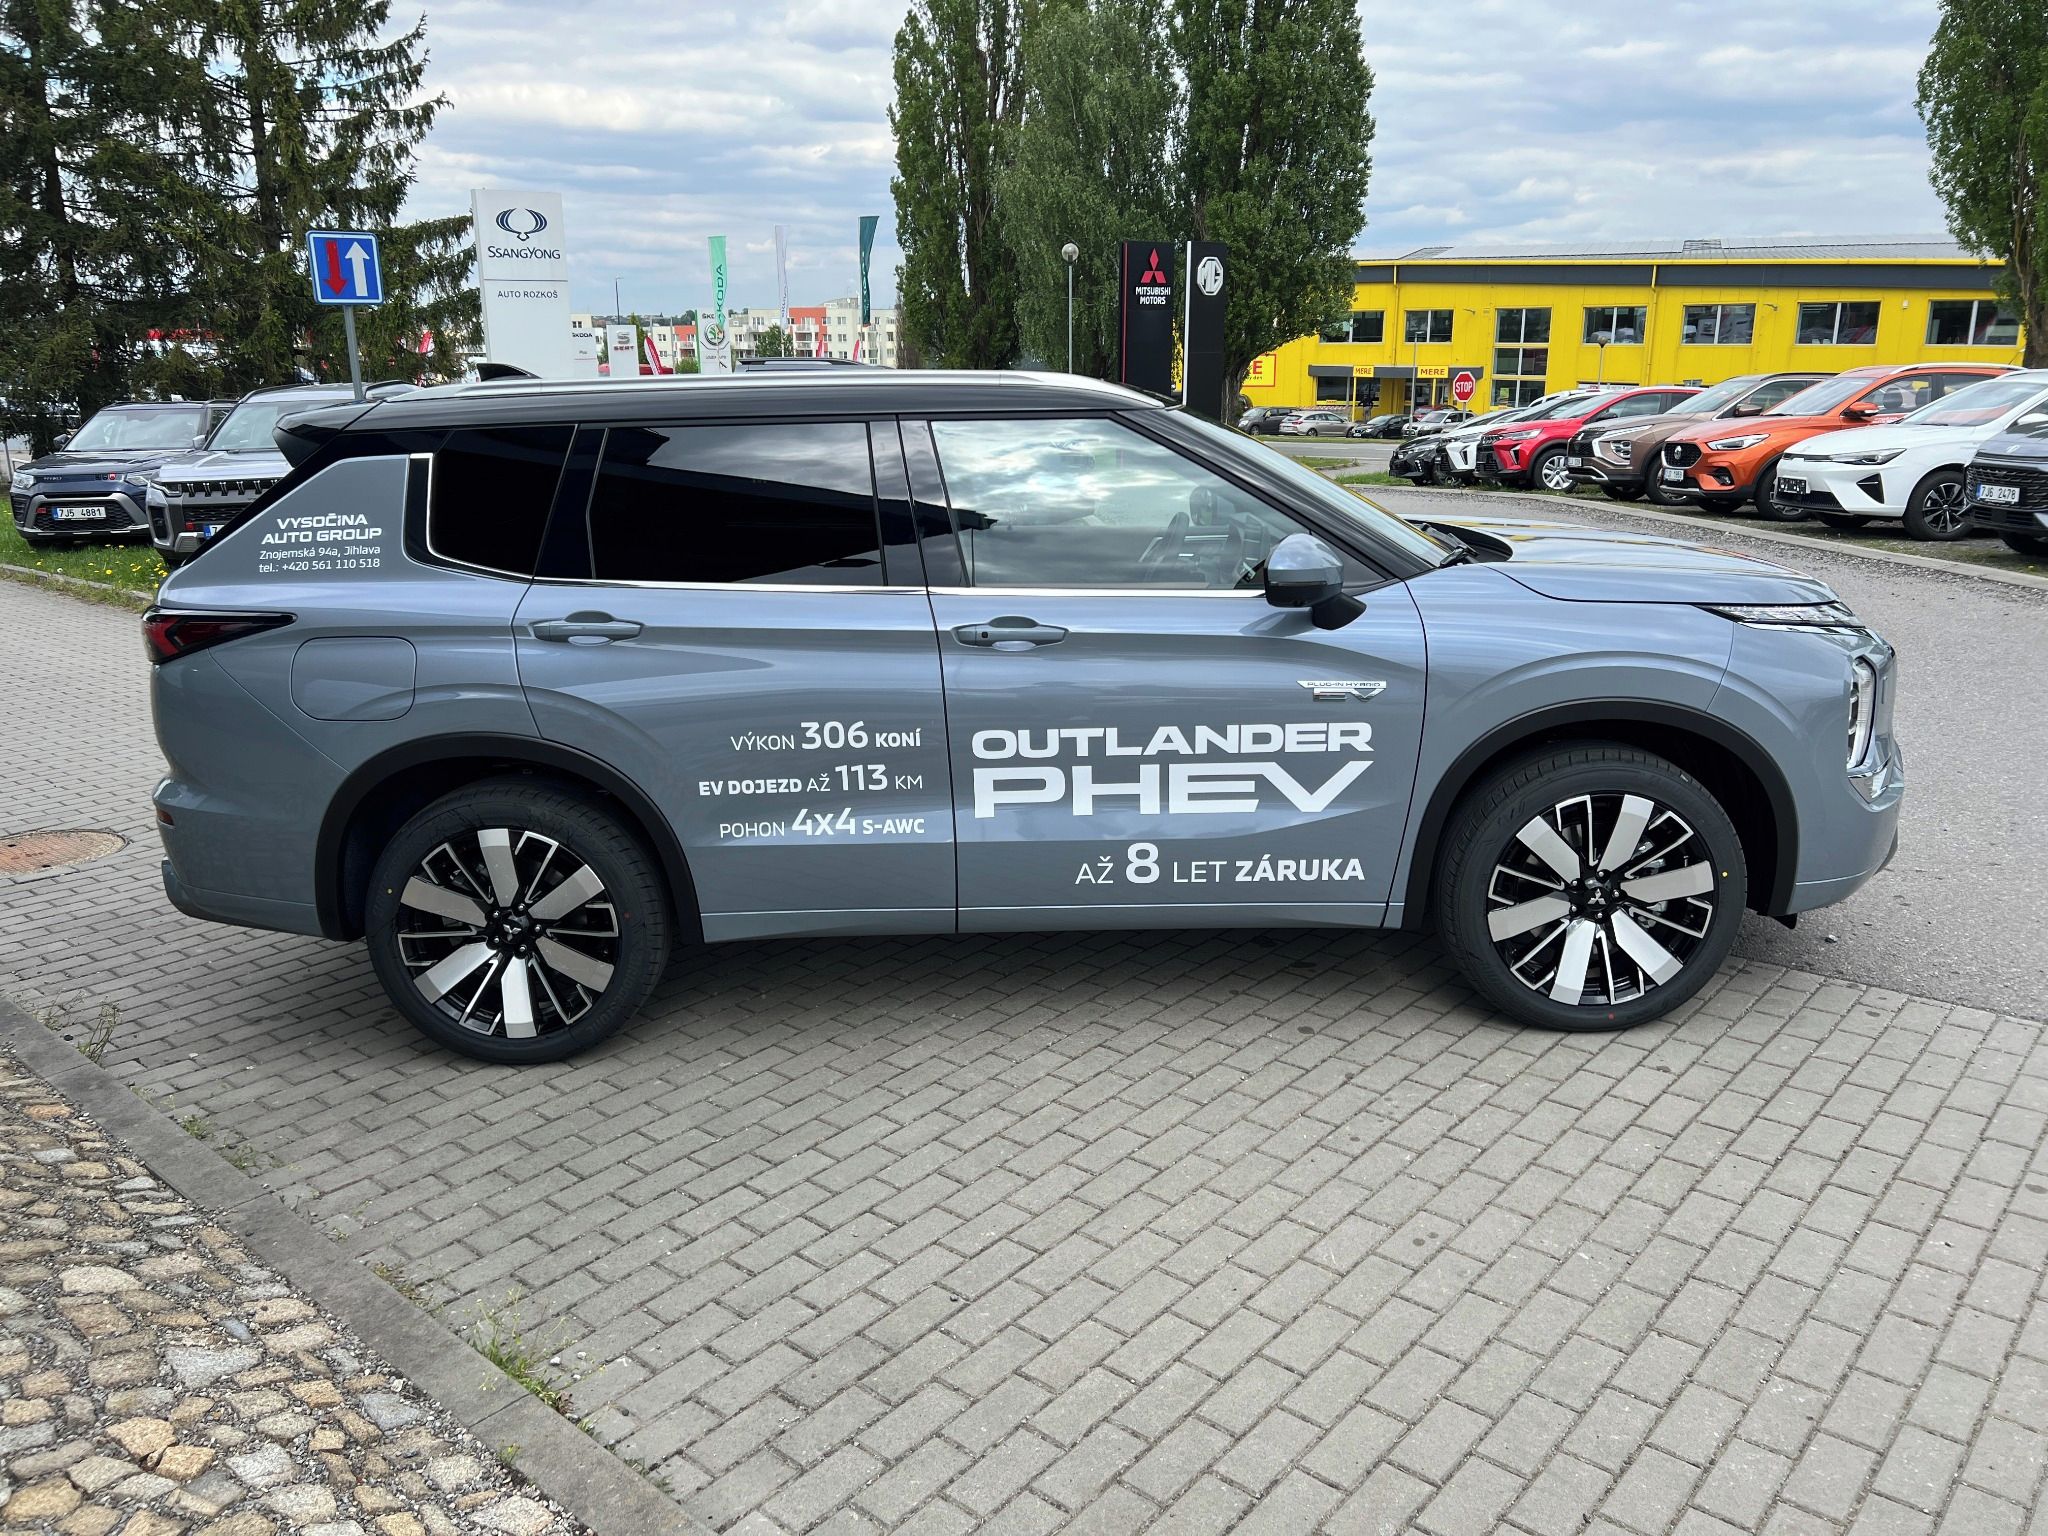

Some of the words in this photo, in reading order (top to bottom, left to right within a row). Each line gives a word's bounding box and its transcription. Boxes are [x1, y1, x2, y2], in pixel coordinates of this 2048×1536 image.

[497, 290, 521, 298] AUTO
[523, 289, 558, 298] ROZKOŠ
[1135, 286, 1171, 295] MITSUBISHI
[1139, 296, 1166, 305] MOTORS
[1354, 367, 1373, 376] MERE
[1420, 368, 1446, 376] MERE
[1455, 381, 1473, 393] STOP
[1981, 486, 1994, 498] 7J6
[59, 508, 75, 518] 7J5
[81, 507, 102, 517] 4881
[261, 531, 313, 544] AUTO
[316, 527, 382, 541] GROUP
[260, 547, 316, 560] Znojemská
[318, 547, 341, 557] 94a,
[344, 545, 381, 555] Jihlava
[259, 562, 279, 572] tel.:
[282, 561, 309, 571] +420
[311, 560, 332, 569] 561
[335, 559, 356, 568] 110
[359, 558, 380, 568] 518
[731, 732, 795, 750] VÝKON
[801, 721, 869, 749] 306
[876, 728, 921, 748] KONÍ
[972, 722, 1375, 760] OUTLANDER
[698, 781, 724, 796] EV
[728, 778, 802, 795] DOJEZD
[806, 773, 831, 792] AŽ
[835, 764, 888, 791] 113
[895, 775, 923, 790] KM
[973, 761, 1375, 819] PHEV
[720, 821, 785, 839] POHON
[863, 818, 925, 835] S-AWC
[1075, 856, 1114, 885] AŽ
[1125, 842, 1160, 884] 8
[1174, 861, 1228, 883] LET
[1235, 854, 1365, 882] ZÁRUKA
